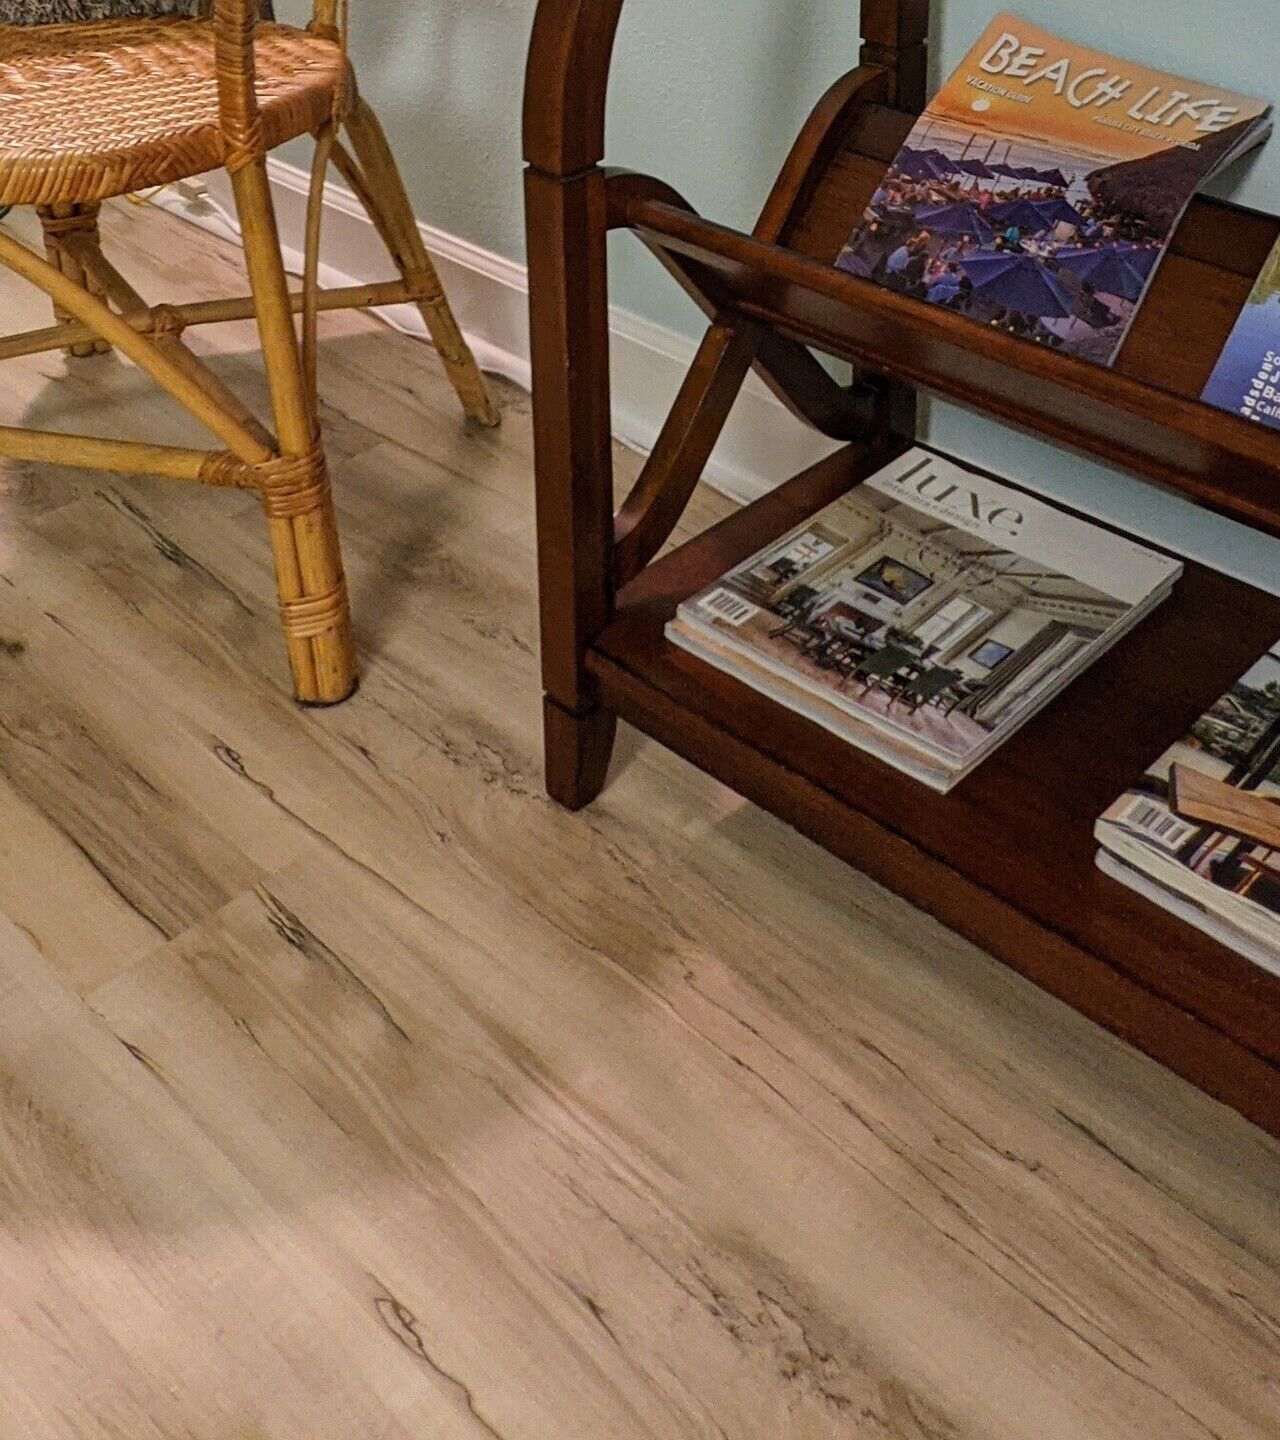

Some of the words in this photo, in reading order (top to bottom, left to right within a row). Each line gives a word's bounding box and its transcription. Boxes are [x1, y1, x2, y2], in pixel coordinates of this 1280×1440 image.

[979, 32, 1132, 108] BEACH
[1126, 85, 1240, 133] LIFE
[1240, 361, 1274, 417] adsden
